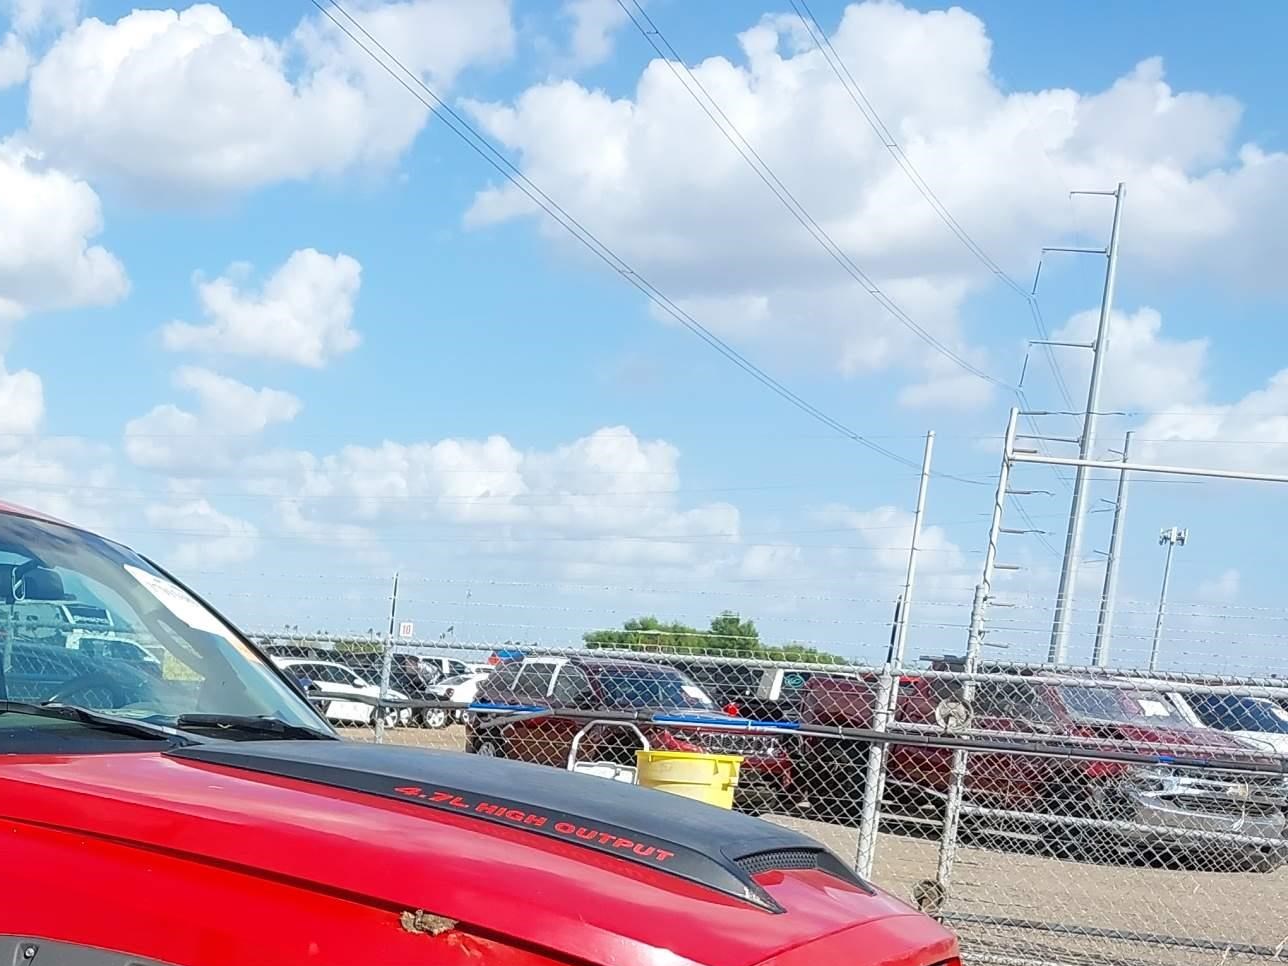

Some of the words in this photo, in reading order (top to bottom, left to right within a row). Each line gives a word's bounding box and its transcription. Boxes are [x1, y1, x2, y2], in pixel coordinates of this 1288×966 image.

[394, 785, 469, 808] 4.7L
[475, 801, 547, 827] HIGH
[554, 821, 674, 862] OUTPUT
